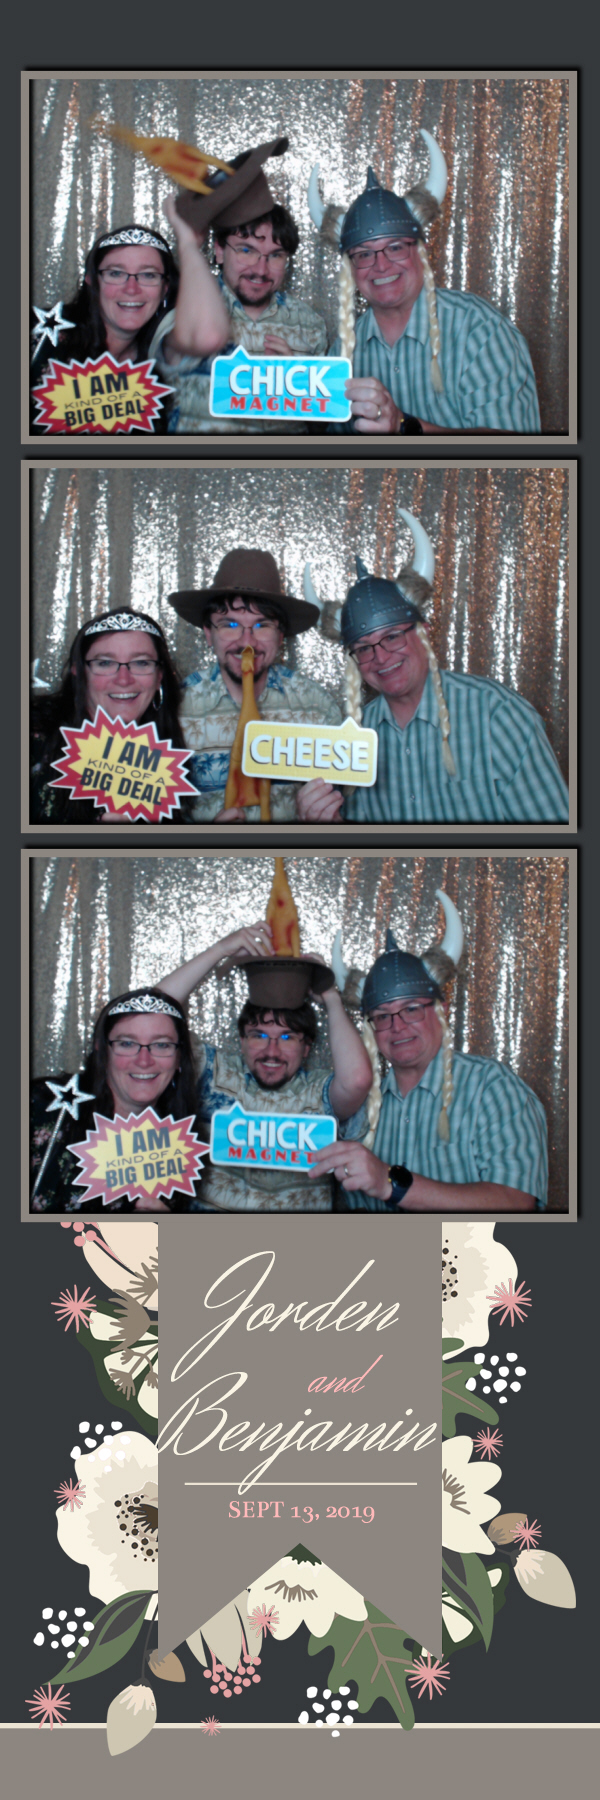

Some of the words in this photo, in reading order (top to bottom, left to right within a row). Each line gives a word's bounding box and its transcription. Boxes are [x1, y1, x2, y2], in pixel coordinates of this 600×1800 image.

[72, 378, 81, 399] I
[90, 371, 129, 396] AM
[229, 364, 332, 397] CHICK
[64, 397, 103, 410] KIND
[106, 392, 127, 403] OF
[132, 390, 144, 398] A
[64, 407, 96, 427] BIG
[101, 399, 146, 420] DEAL
[230, 396, 331, 413] MAGNET
[102, 736, 114, 760] I
[117, 740, 162, 773] AM
[250, 734, 369, 773] CHEESE
[80, 767, 114, 792] BIG
[117, 777, 162, 806] DEAL
[87, 758, 127, 775] KIND
[130, 769, 153, 780] OF
[154, 776, 166, 786] A
[114, 1134, 124, 1157] I
[132, 1126, 171, 1154] AM
[227, 1118, 318, 1151] CHICK
[106, 1155, 145, 1169] KIND
[148, 1150, 169, 1161] OF
[173, 1148, 184, 1157] A
[228, 1146, 314, 1165] MAGNET
[105, 1166, 138, 1188] BIG
[142, 1157, 188, 1181] DEAL
